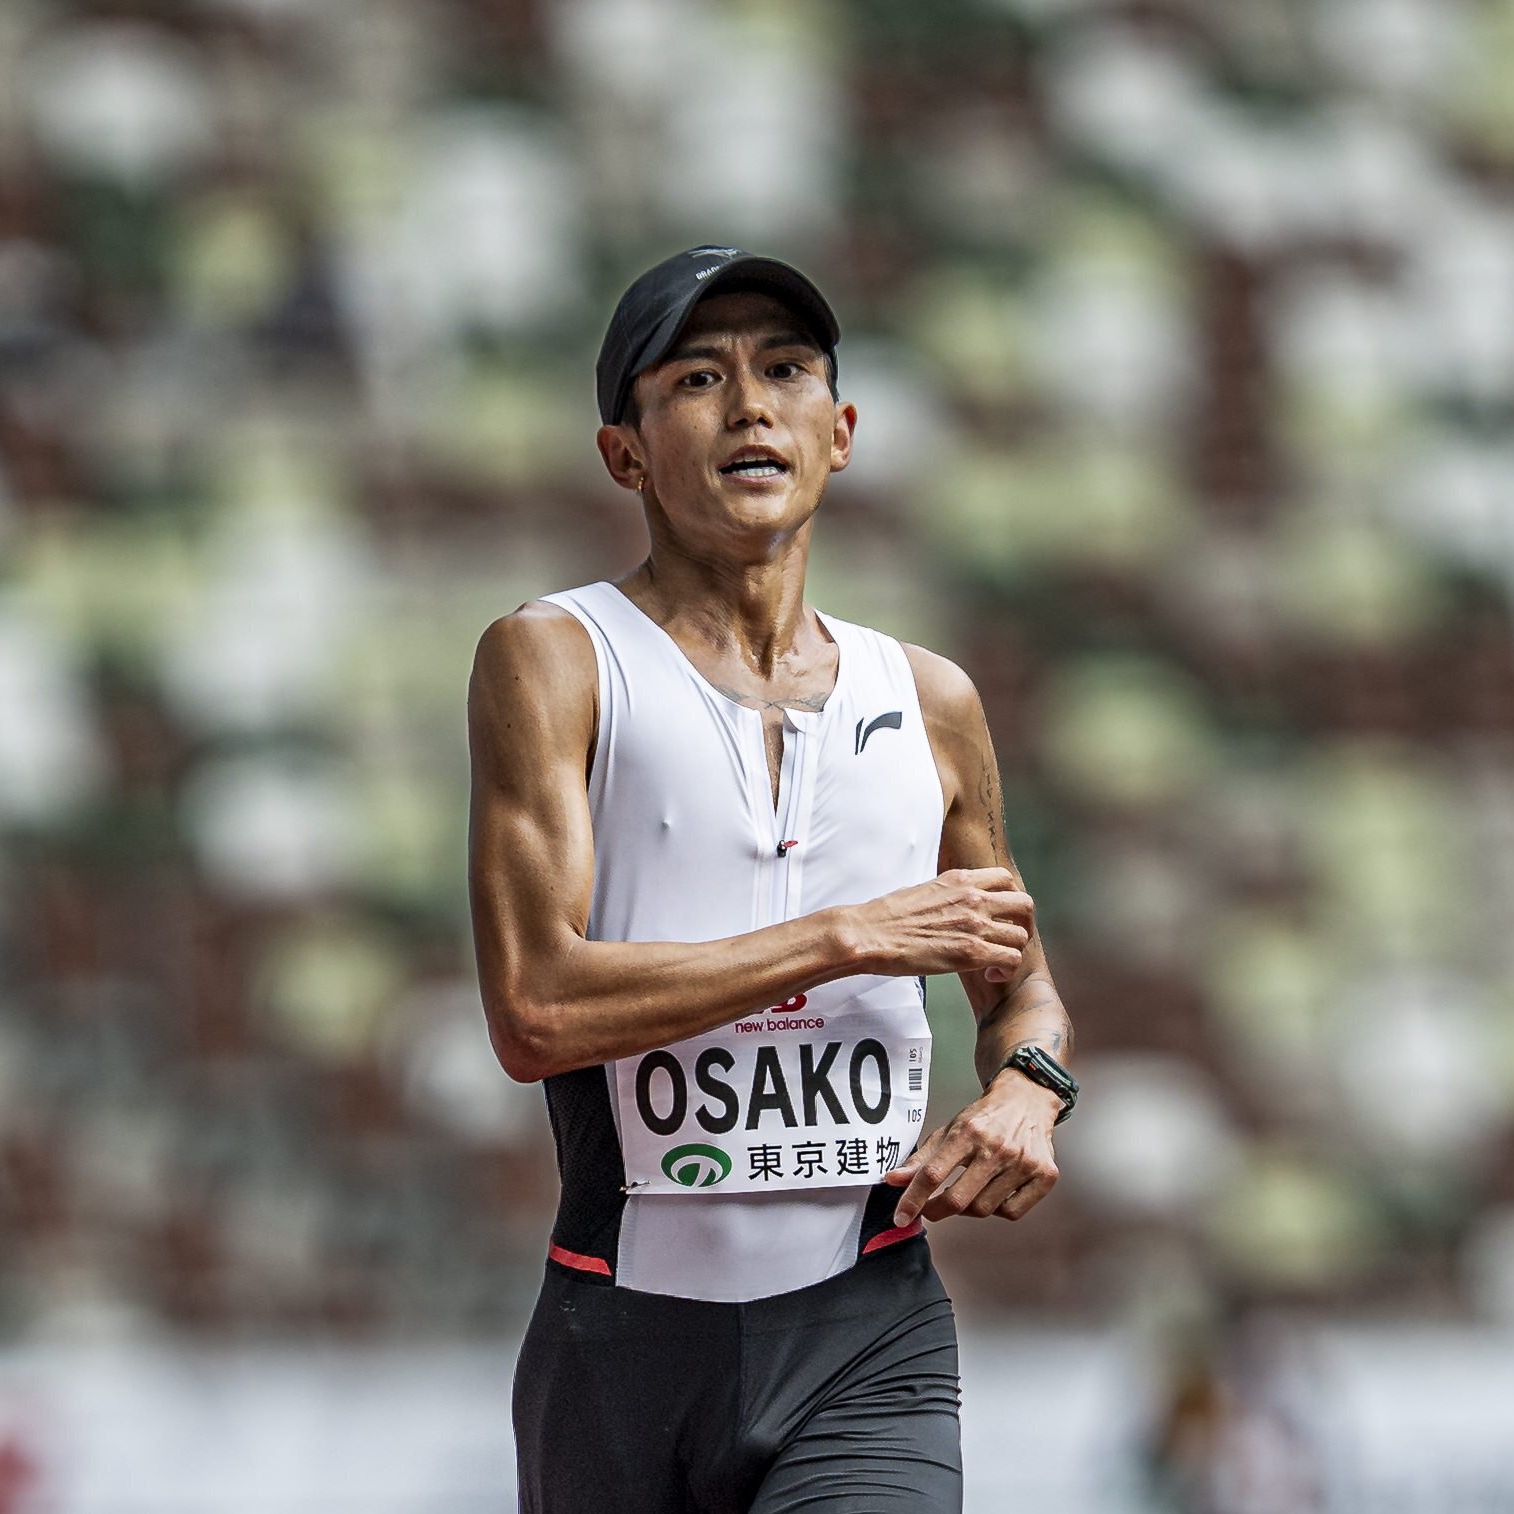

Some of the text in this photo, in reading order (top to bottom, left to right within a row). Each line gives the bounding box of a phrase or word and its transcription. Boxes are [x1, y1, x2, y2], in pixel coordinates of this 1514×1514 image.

[734, 1017, 825, 1034] new balance
[635, 1037, 892, 1136] OSAKO
[907, 1108, 923, 1123] 105
[746, 1136, 901, 1182] 東京建物
